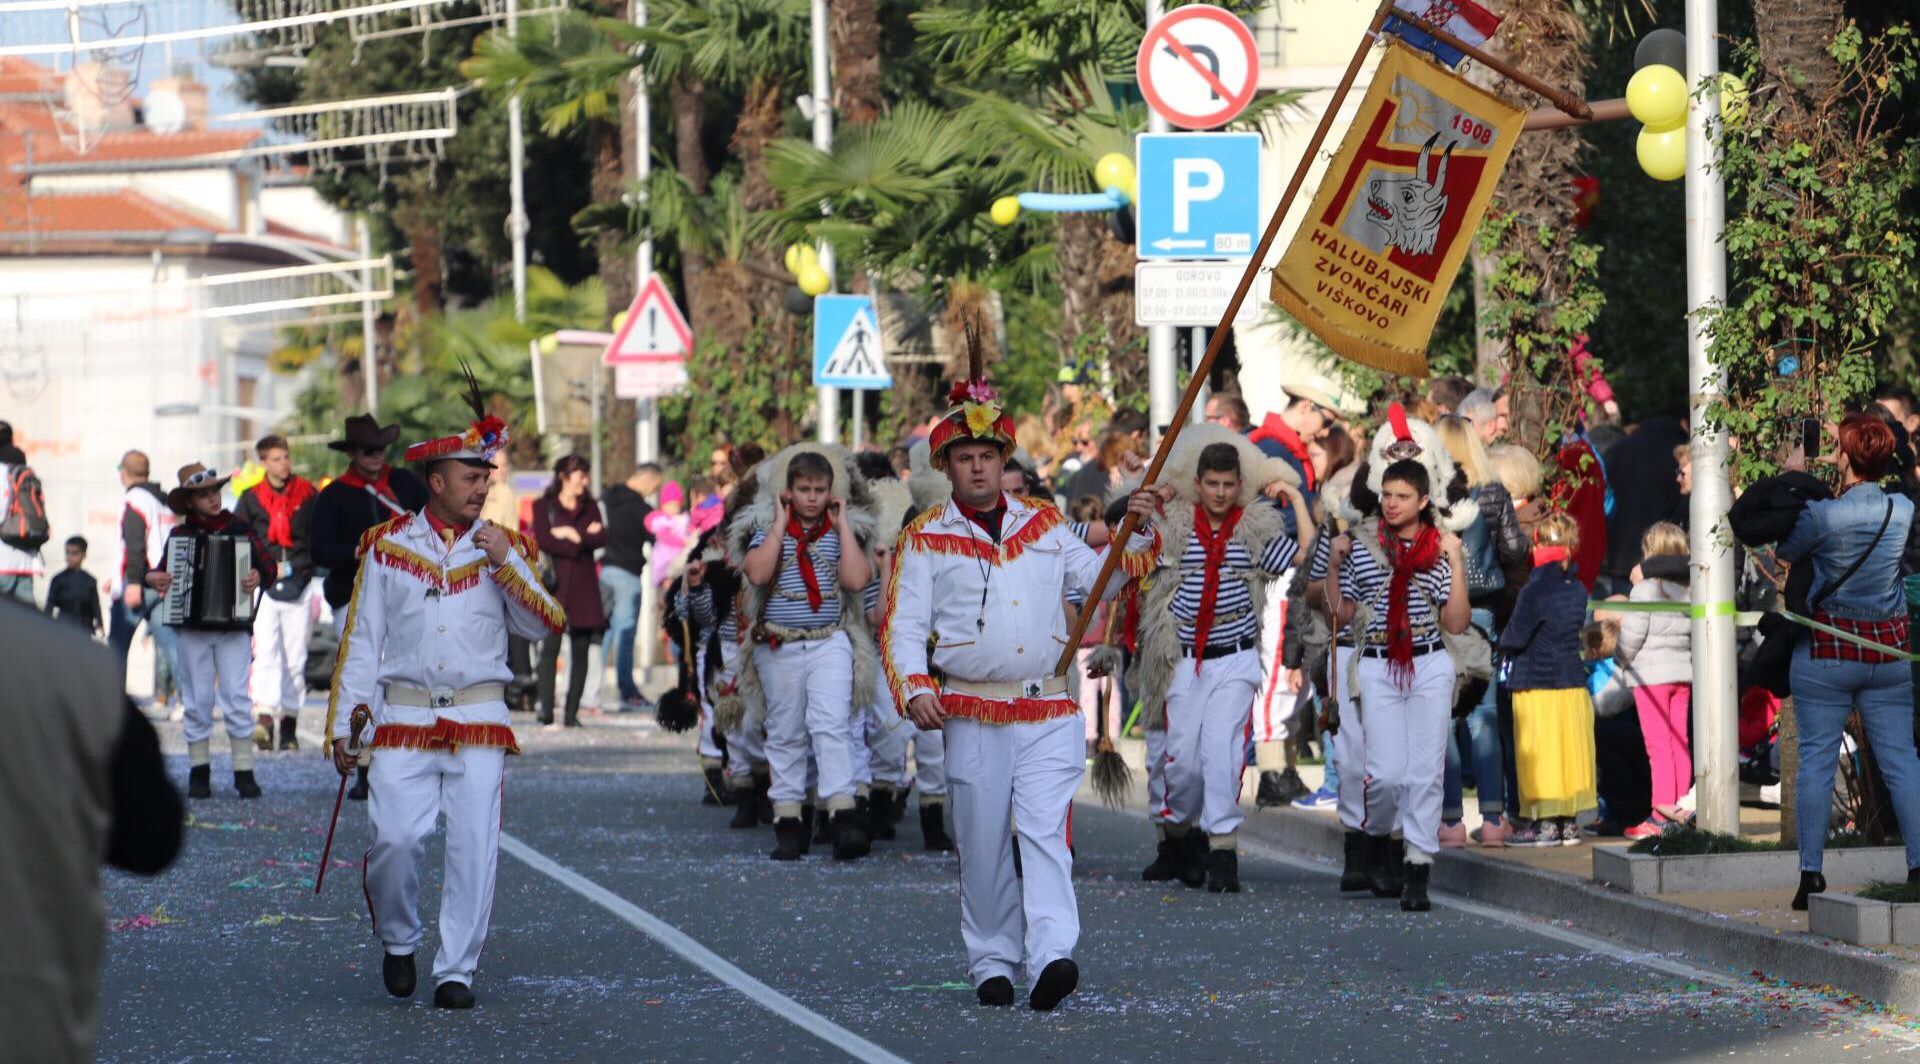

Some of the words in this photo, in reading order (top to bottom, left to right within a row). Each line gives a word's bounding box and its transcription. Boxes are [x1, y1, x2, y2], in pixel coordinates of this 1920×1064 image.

[1451, 113, 1493, 144] 1908
[1173, 158, 1225, 233] P
[1216, 236, 1232, 249] 80
[1236, 239, 1249, 249] m
[1310, 228, 1431, 305] HALUBAJSKI
[1175, 270, 1221, 282] GOROVO
[1314, 256, 1409, 318] ZVONČARI
[1316, 280, 1390, 330] VIŠKOVO
